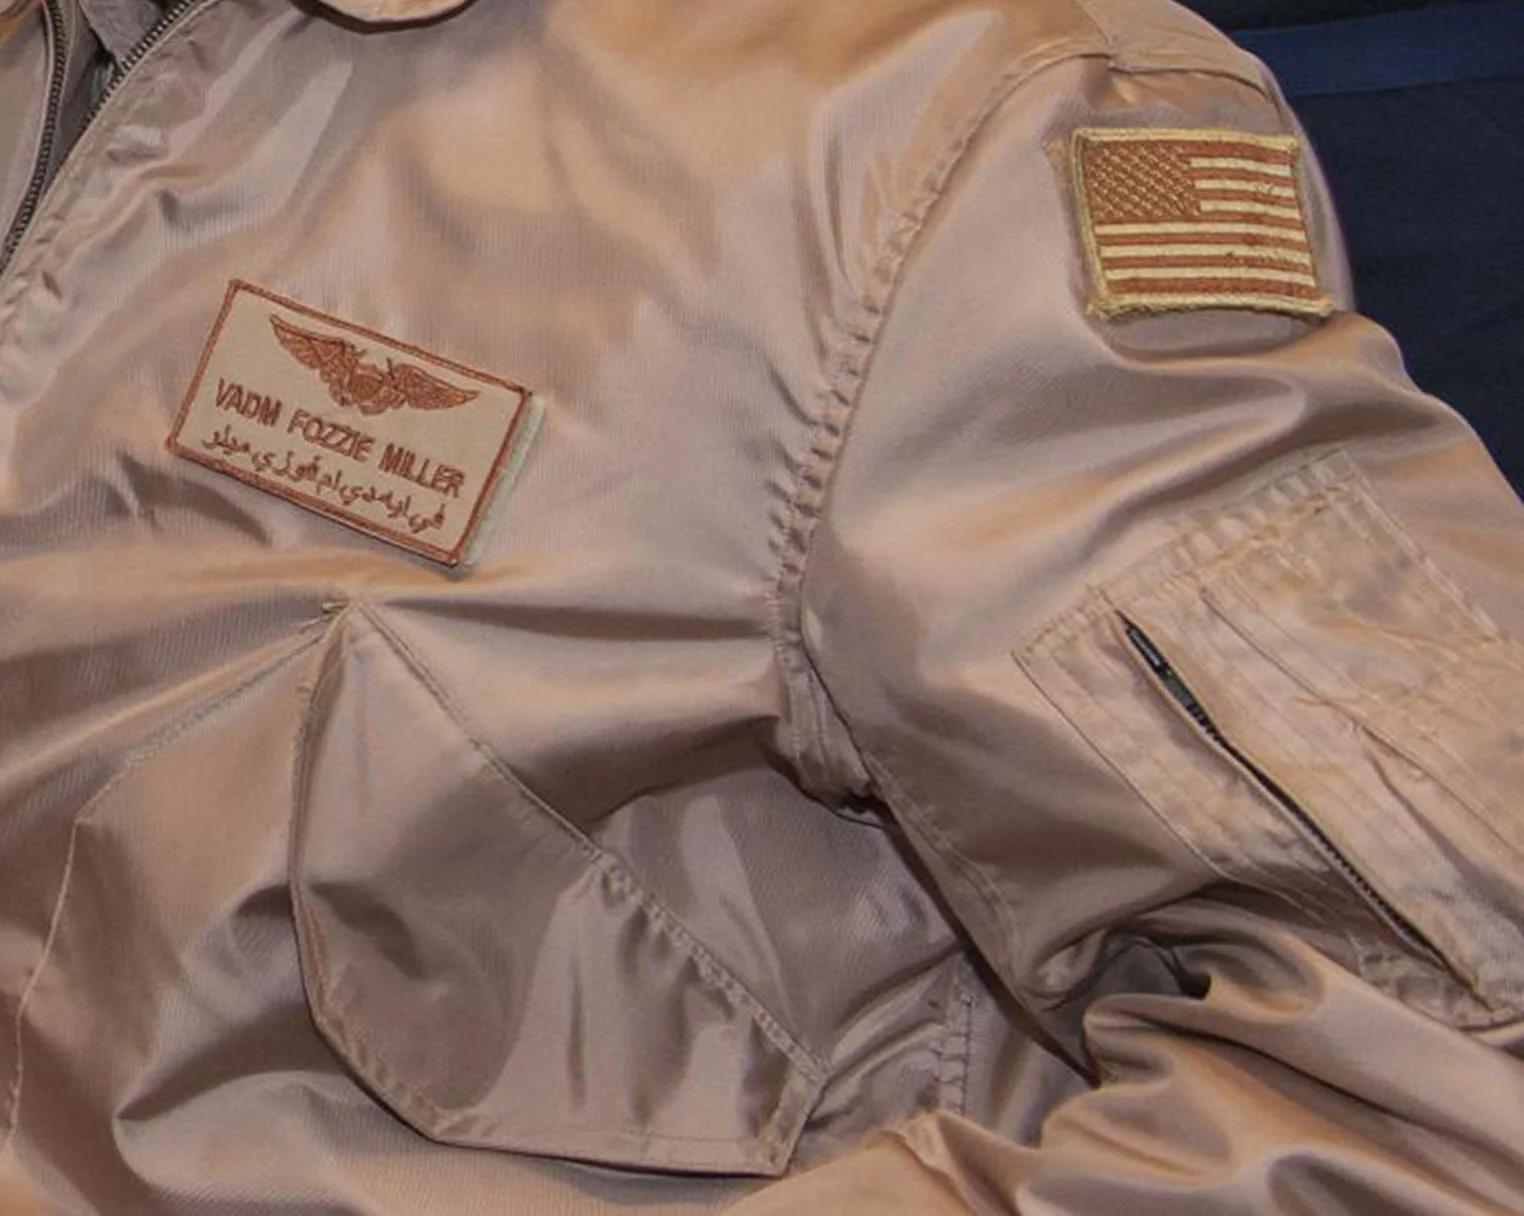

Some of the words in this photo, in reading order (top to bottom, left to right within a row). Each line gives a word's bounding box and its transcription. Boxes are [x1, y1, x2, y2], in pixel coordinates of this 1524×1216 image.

[214, 377, 283, 428] VADM
[287, 408, 377, 463] FOZZIE
[378, 442, 466, 499] MILLER
